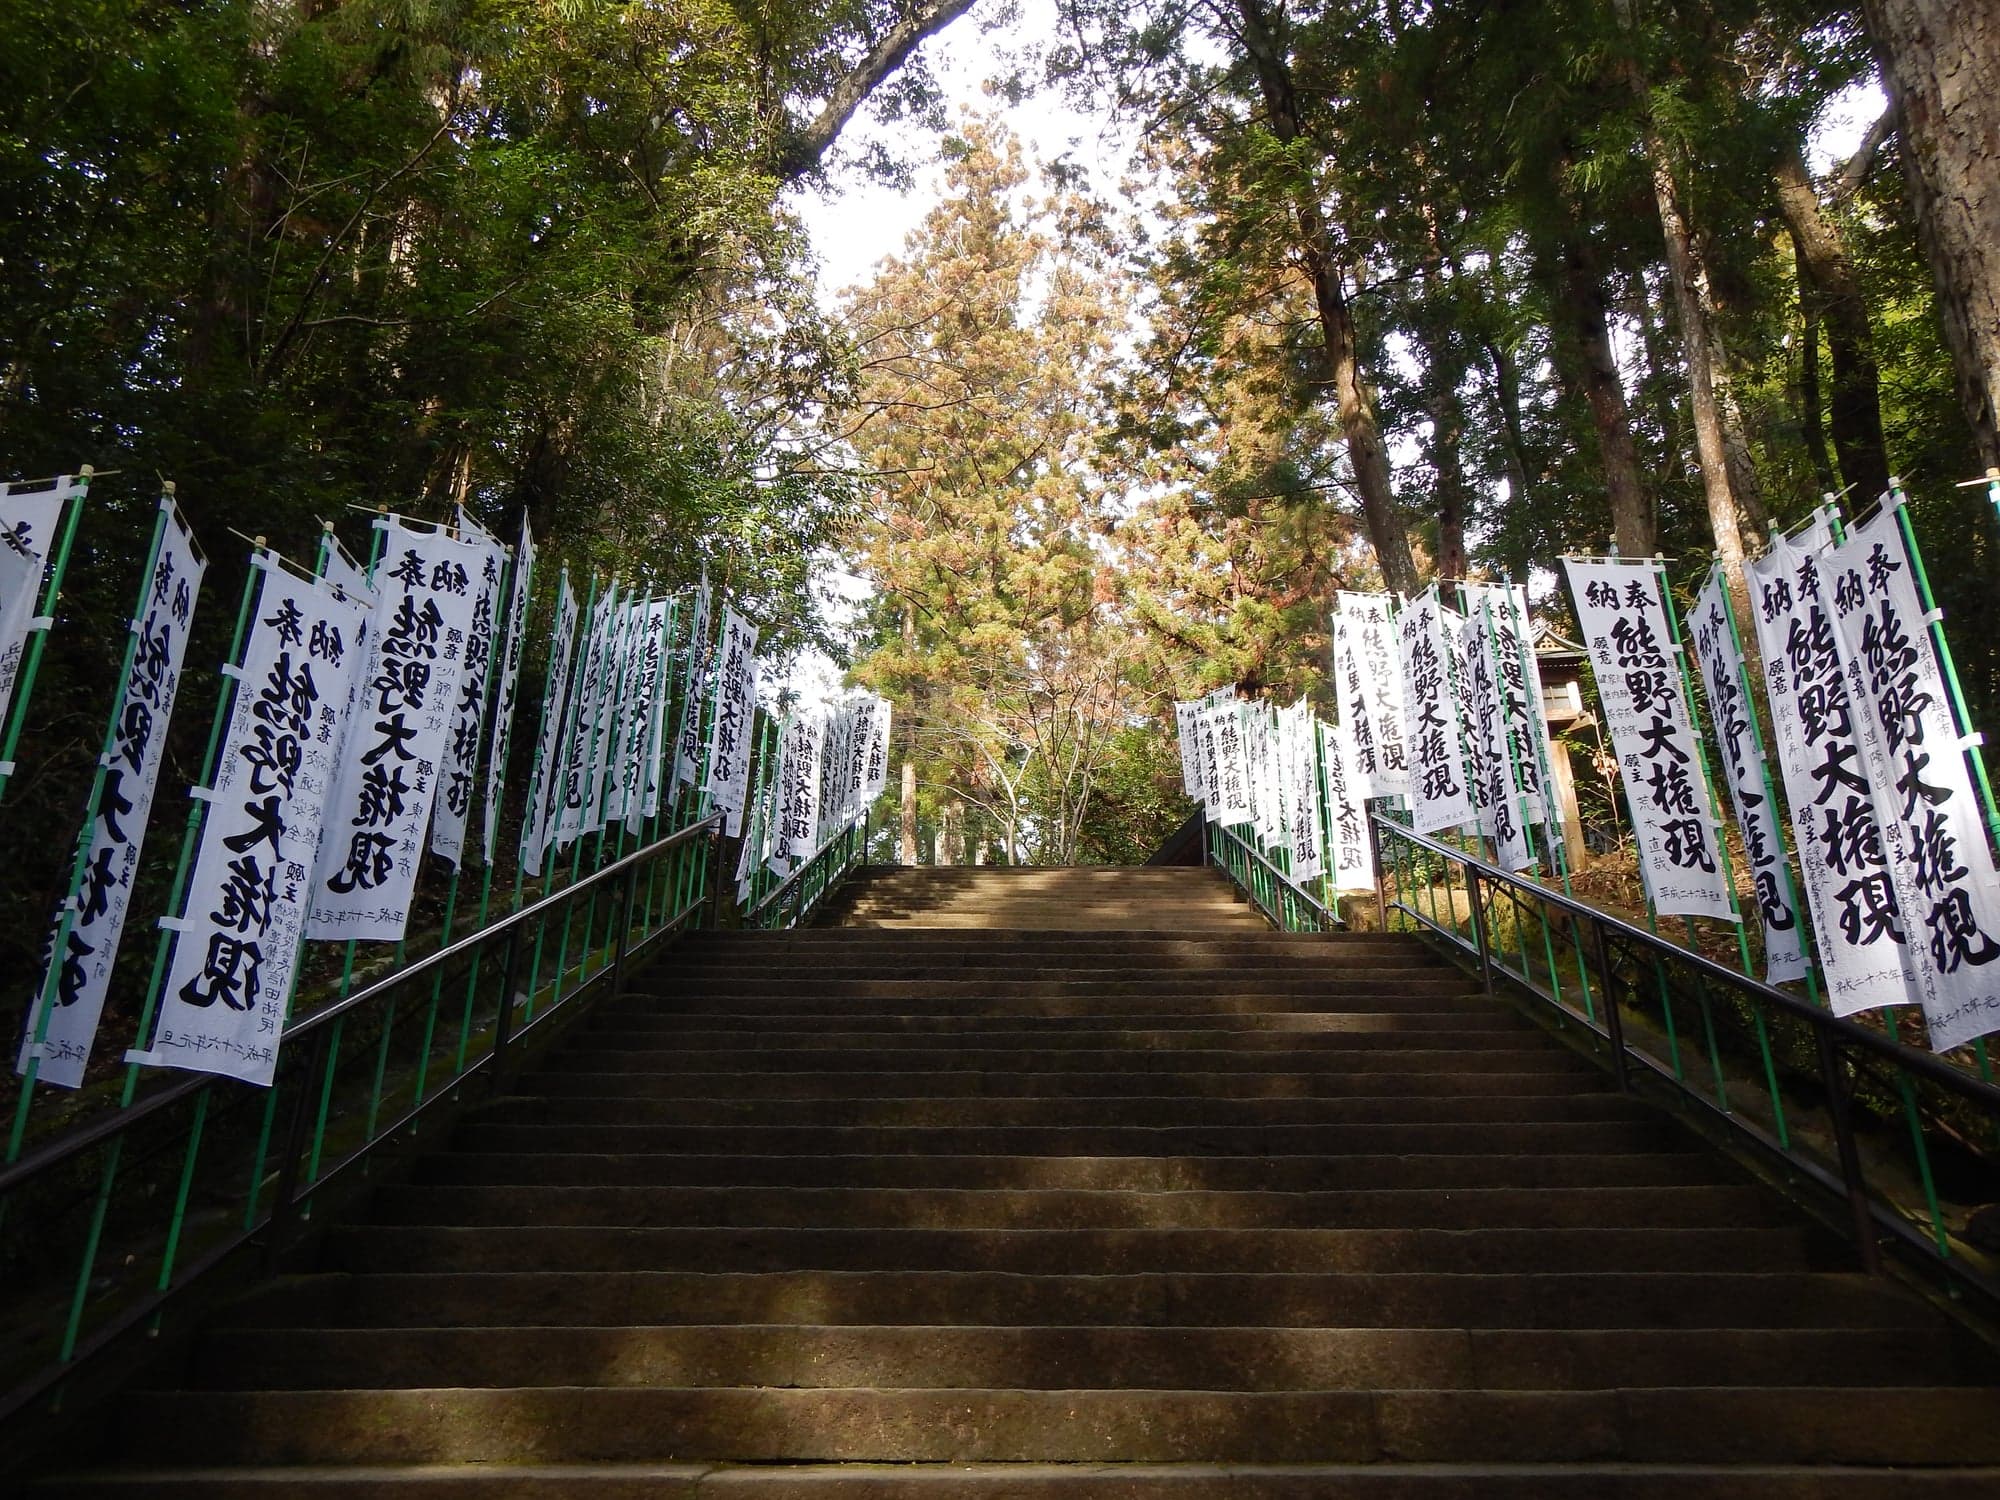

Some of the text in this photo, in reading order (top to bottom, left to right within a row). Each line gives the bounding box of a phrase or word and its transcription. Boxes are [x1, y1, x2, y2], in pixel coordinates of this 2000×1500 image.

[1585, 580, 1657, 615] 奉納
[1762, 554, 1821, 624] 奉納
[1835, 543, 1902, 619] 奉納
[1592, 636, 1612, 665] 願意
[1768, 656, 1788, 697] 願意
[1411, 633, 1460, 801] 熊野大権現
[1611, 616, 1716, 874] 熊野大権現
[1623, 753, 1644, 783] 願主
[1786, 605, 1907, 946] 熊野大権現
[1861, 598, 2000, 974] 熊野大権現
[1798, 804, 1819, 847] 願主
